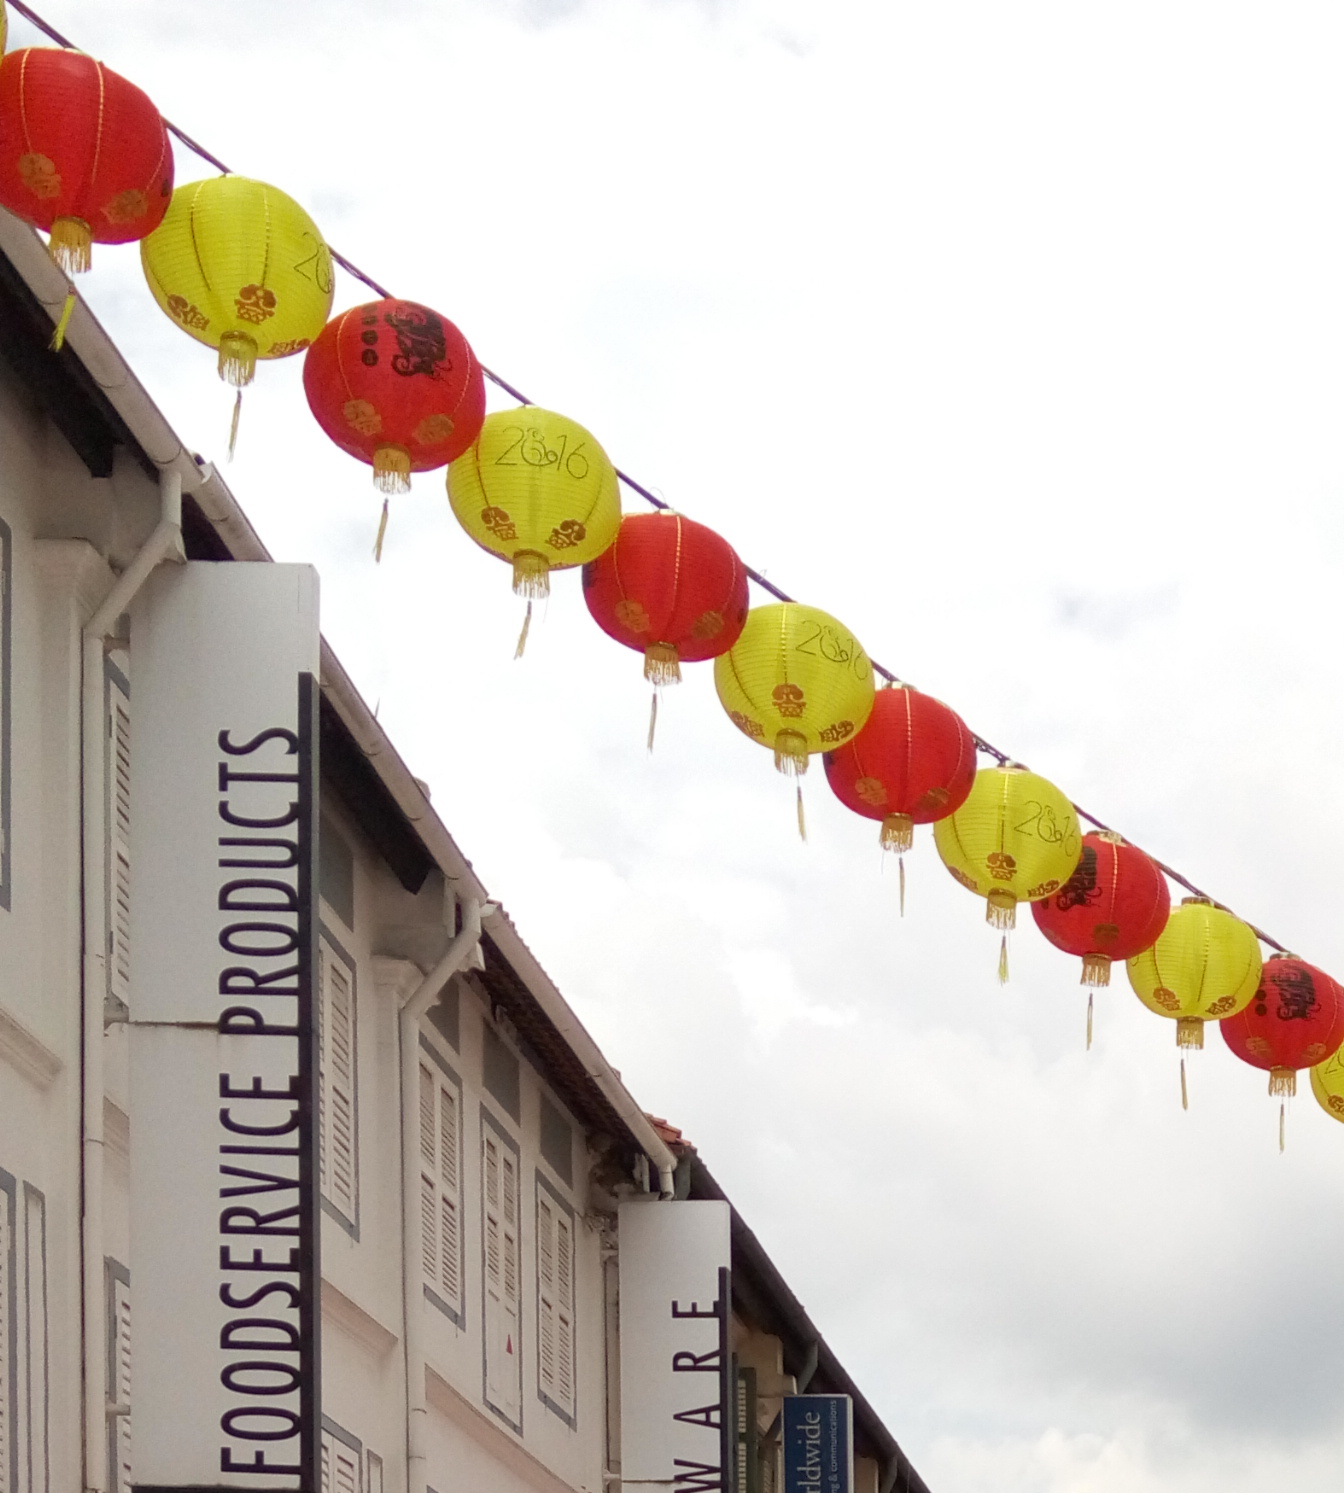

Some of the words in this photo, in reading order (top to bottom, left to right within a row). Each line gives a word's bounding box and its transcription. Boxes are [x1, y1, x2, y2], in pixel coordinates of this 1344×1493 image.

[218, 725, 301, 1036] PRODUCTS
[218, 1072, 302, 1476] FOODSERVICE
[828, 1472, 839, 1482] &
[829, 1400, 838, 1472] communications
